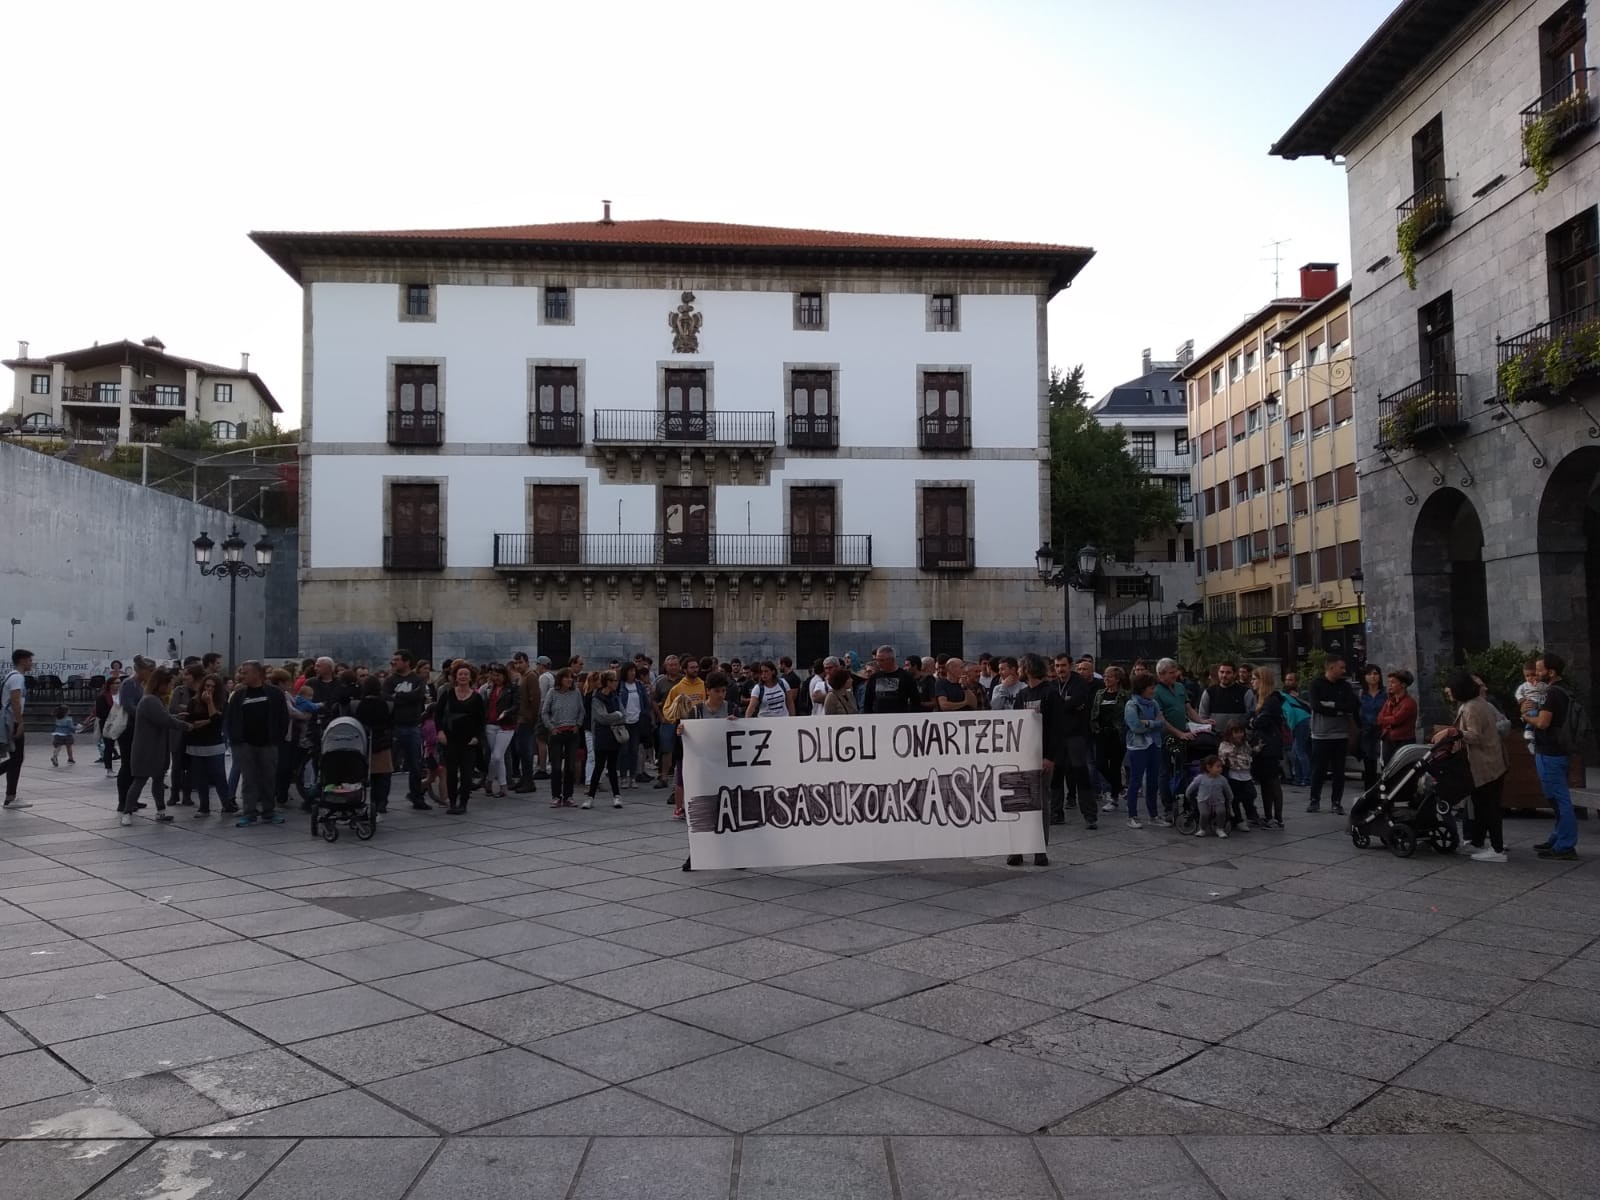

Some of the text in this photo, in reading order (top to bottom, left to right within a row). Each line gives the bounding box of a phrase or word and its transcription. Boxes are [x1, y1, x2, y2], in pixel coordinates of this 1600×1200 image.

[726, 718, 1024, 767] EZ DUGU ONARTZEN
[714, 764, 1021, 833] ALTSASUKOAK ASKE
